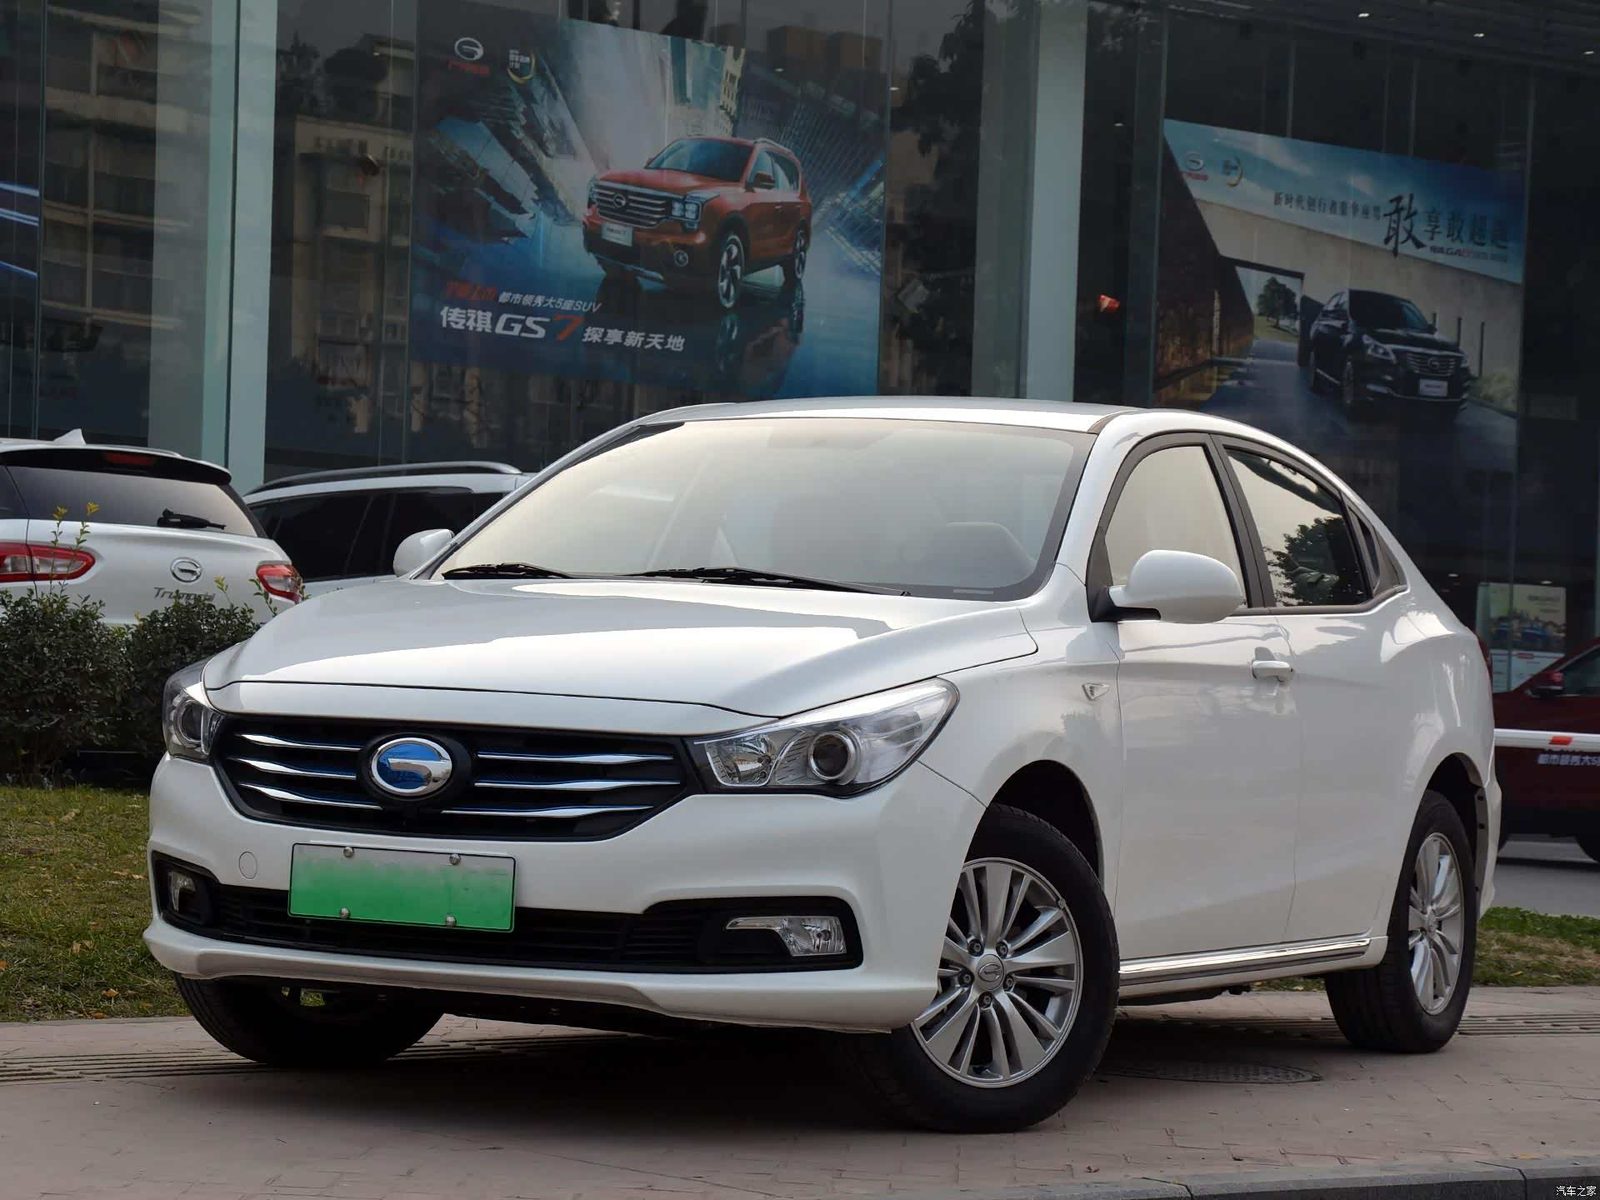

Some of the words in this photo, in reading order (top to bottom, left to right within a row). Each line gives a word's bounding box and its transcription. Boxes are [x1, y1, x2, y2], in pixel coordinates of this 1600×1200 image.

[582, 326, 686, 352] 探享新天地
